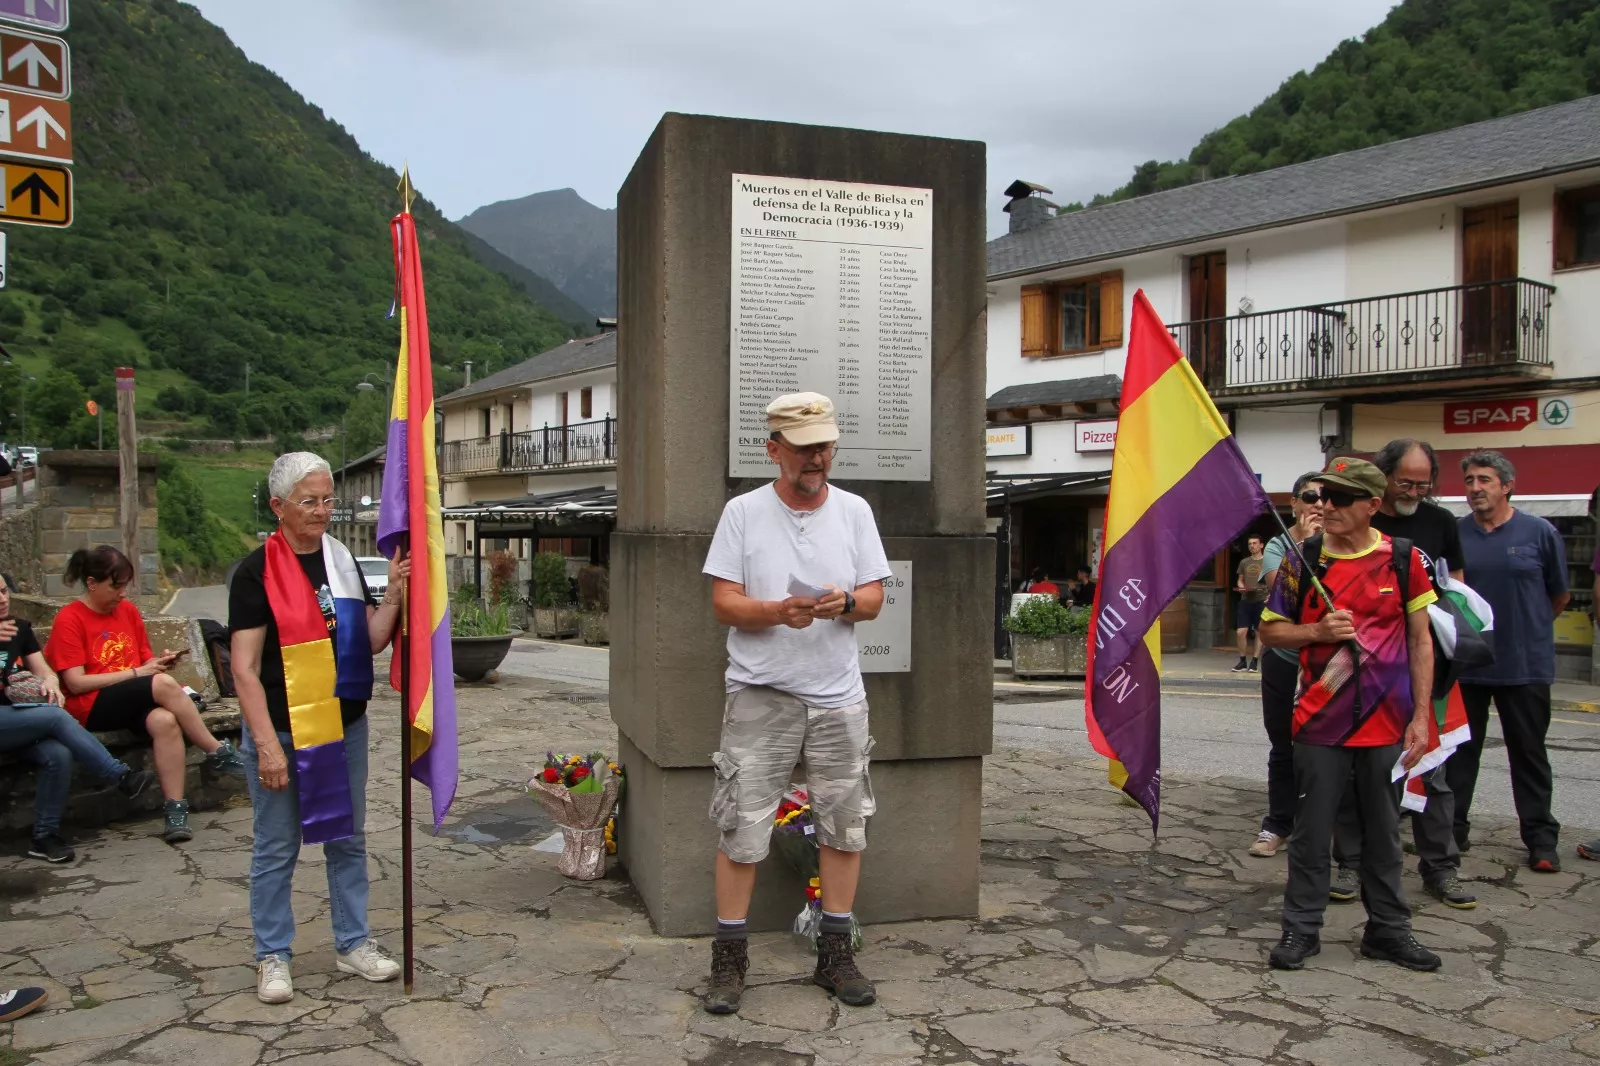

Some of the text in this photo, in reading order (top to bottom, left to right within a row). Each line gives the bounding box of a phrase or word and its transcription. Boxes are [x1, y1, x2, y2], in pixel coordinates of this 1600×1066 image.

[742, 183, 790, 196] Muertos
[812, 188, 822, 198] el
[826, 189, 853, 201] Valle
[856, 191, 871, 202] de
[875, 193, 907, 205] Bielsa
[753, 197, 913, 220] defensa de la República y la
[763, 212, 904, 231] Democracia (1936-1939)
[766, 229, 798, 238] FRENTE
[1453, 406, 1530, 425] SPAR
[896, 578, 904, 588] lo
[886, 594, 895, 604] la
